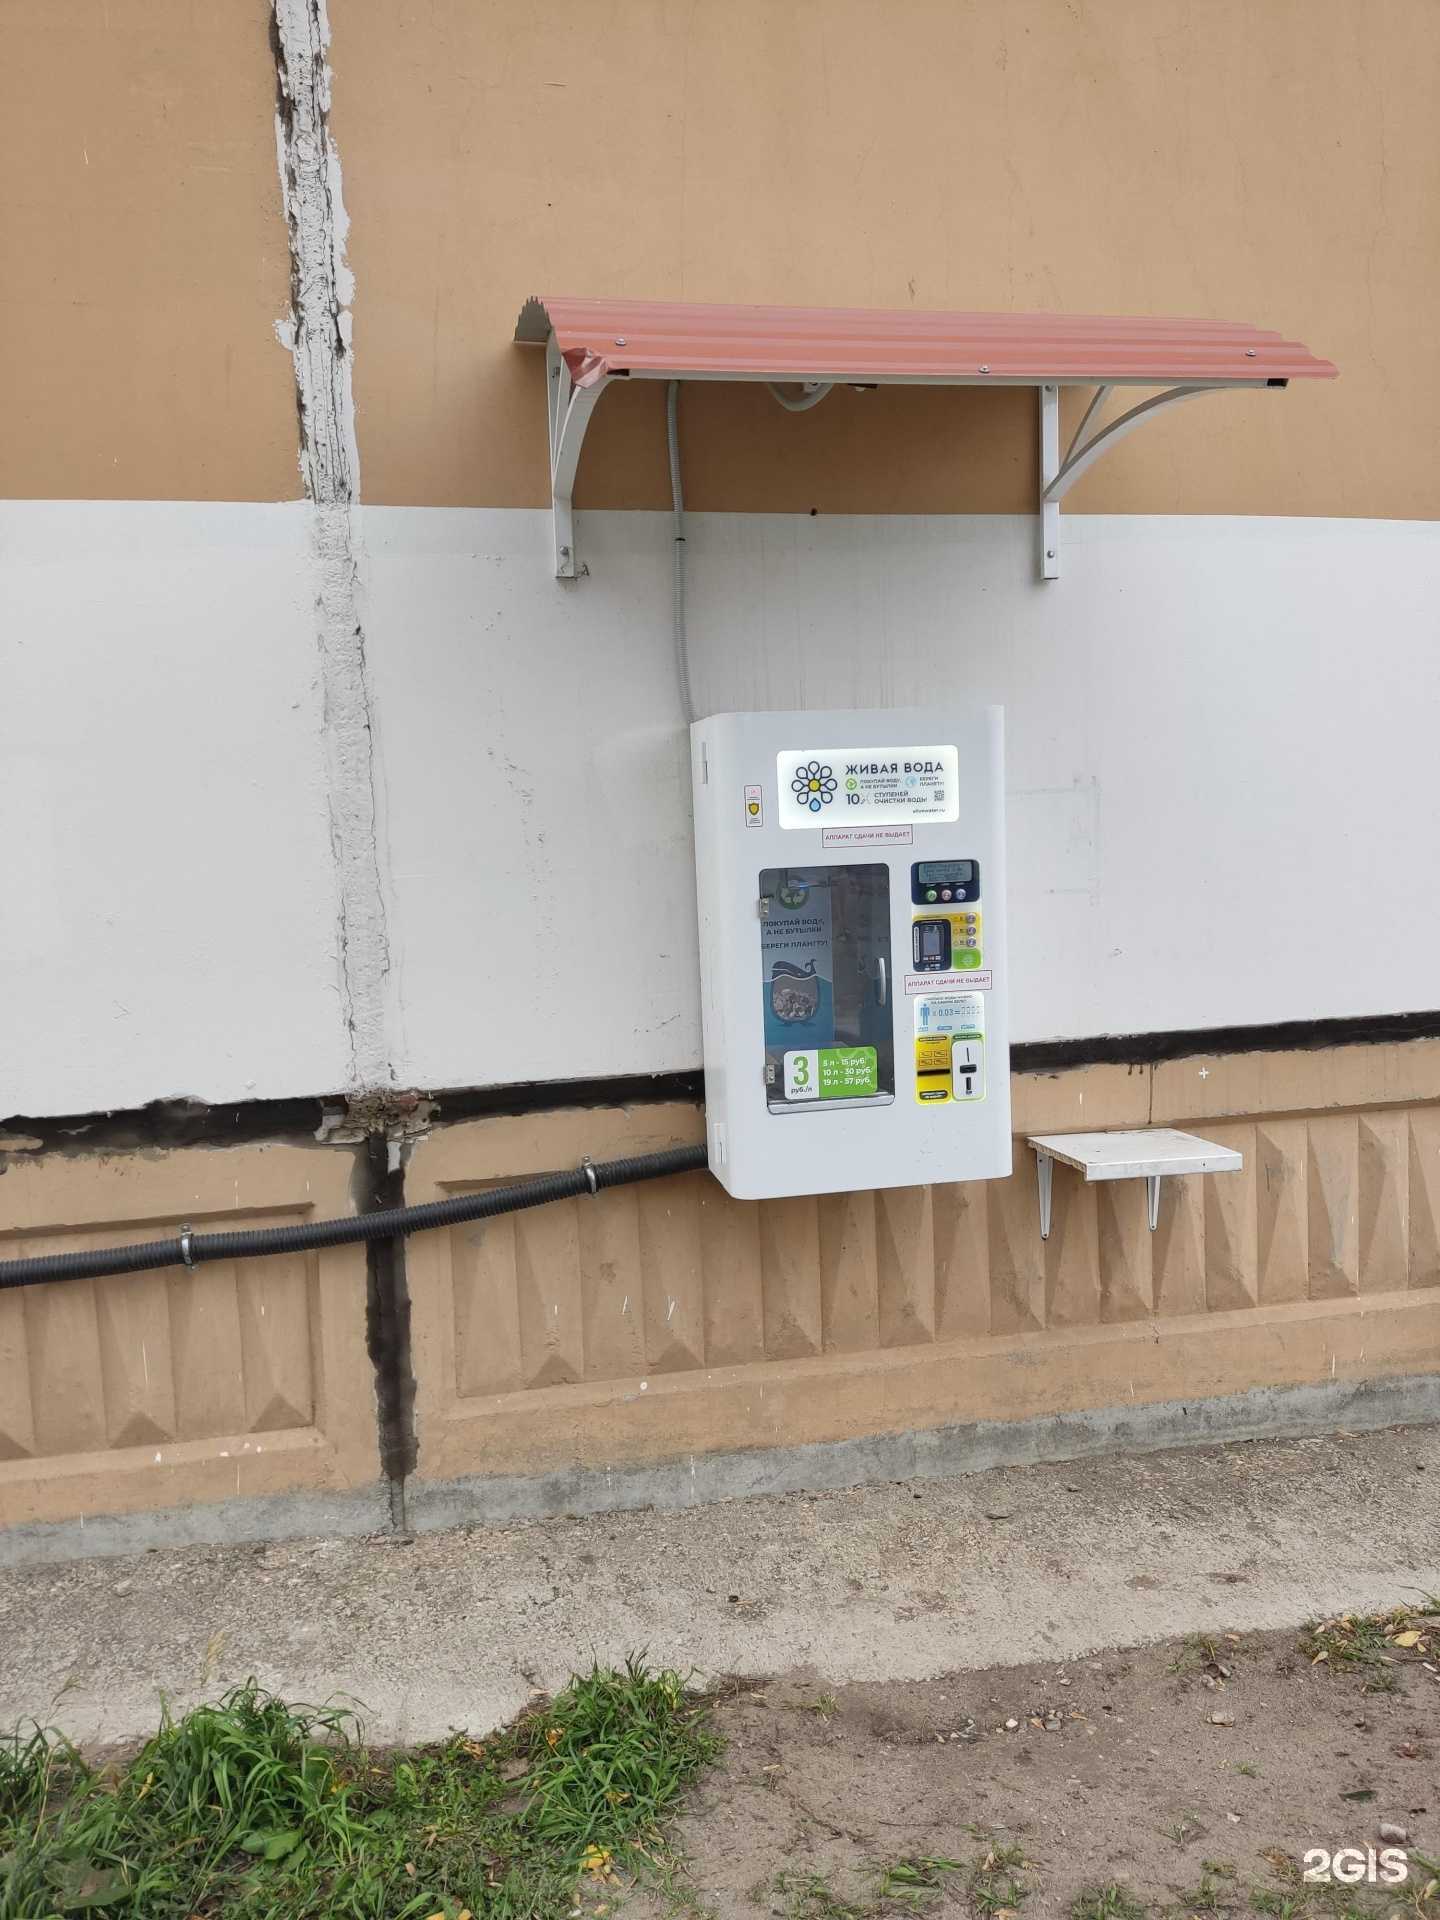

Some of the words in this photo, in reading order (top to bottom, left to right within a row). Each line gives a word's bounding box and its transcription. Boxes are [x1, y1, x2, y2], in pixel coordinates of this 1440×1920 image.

[845, 763, 898, 775] ЖИВАЯ
[904, 761, 944, 773] ВОДА
[825, 833, 852, 841] АППАРАТ
[793, 1056, 809, 1086] 3
